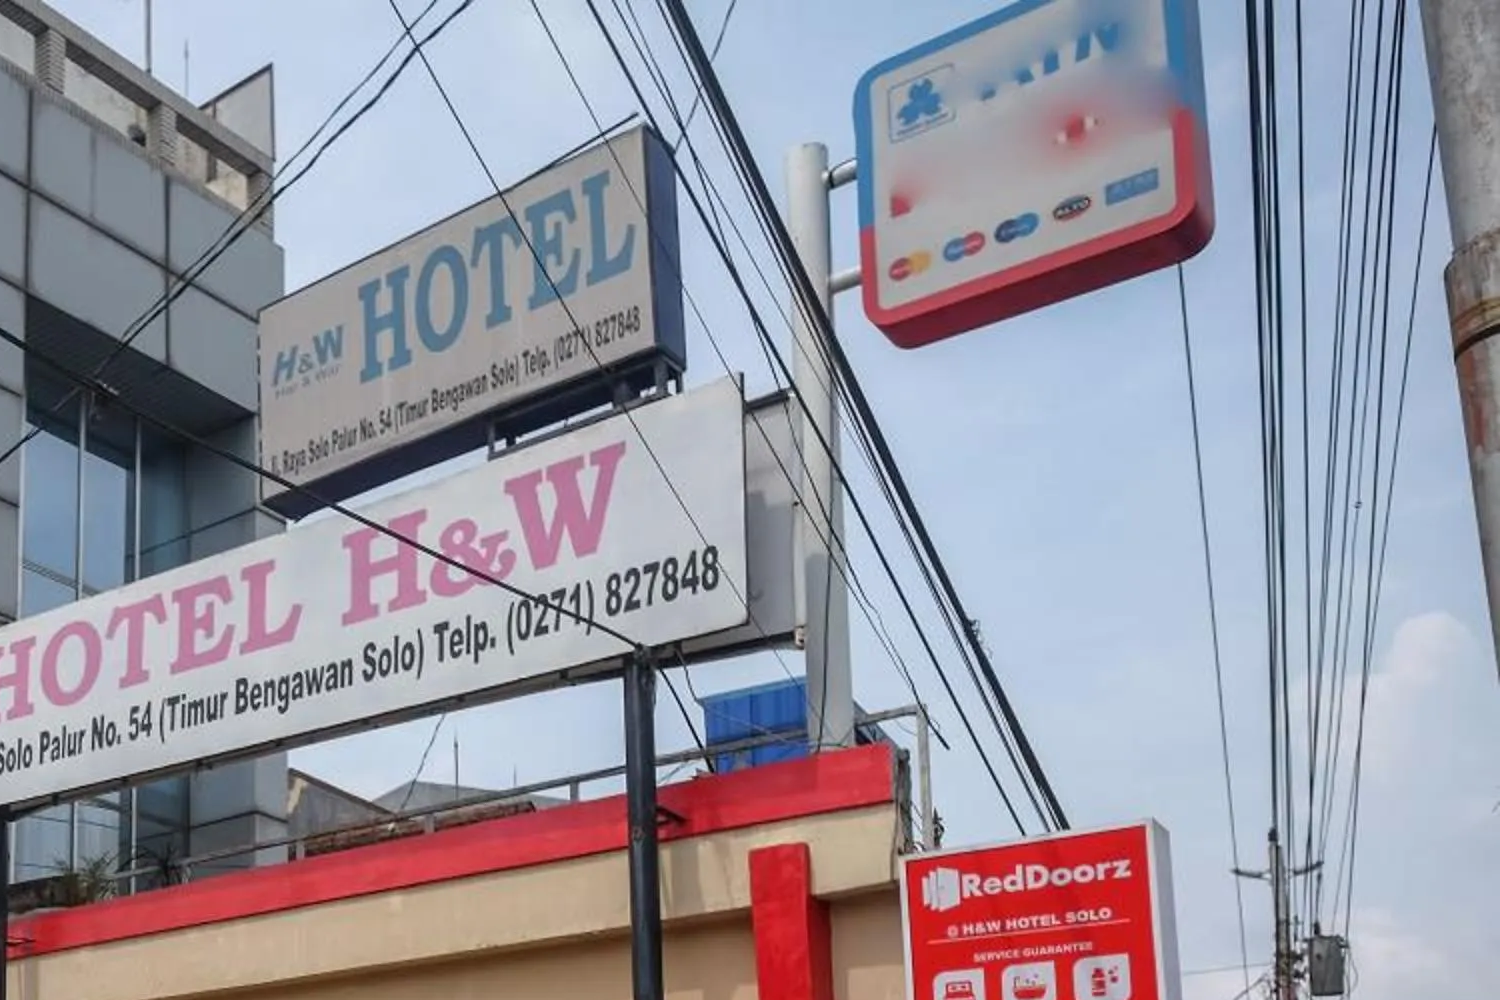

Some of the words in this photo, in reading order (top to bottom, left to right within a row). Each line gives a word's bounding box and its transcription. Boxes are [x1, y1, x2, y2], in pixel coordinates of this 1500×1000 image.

[359, 170, 636, 384] HOTEL
[272, 324, 344, 388] H&W
[283, 450, 306, 475] Raya
[308, 437, 330, 464] Solo
[332, 427, 358, 452] Palur
[360, 418, 378, 442] No.
[379, 408, 393, 434] 54
[431, 374, 488, 413] Bengawan
[522, 345, 551, 377] Telp.
[553, 325, 592, 369] (0271)
[595, 305, 640, 348] 827848
[341, 441, 626, 626] H&W
[40, 727, 86, 764] Palur
[92, 714, 121, 752] No.
[129, 700, 153, 741] 54
[159, 692, 228, 743] (Timur
[235, 658, 354, 716] Bengawan
[362, 628, 424, 683] Solo)
[433, 614, 496, 665] Telp.
[507, 579, 595, 656] (0271)
[606, 545, 720, 618] 827848
[961, 859, 1132, 899] RedDoorz
[963, 919, 1001, 936] H&W
[1006, 912, 1061, 931] HOTEL
[1065, 907, 1112, 923] SOLO
[973, 948, 1020, 963] SERVICE
[1022, 941, 1093, 958] GUARANTEE
